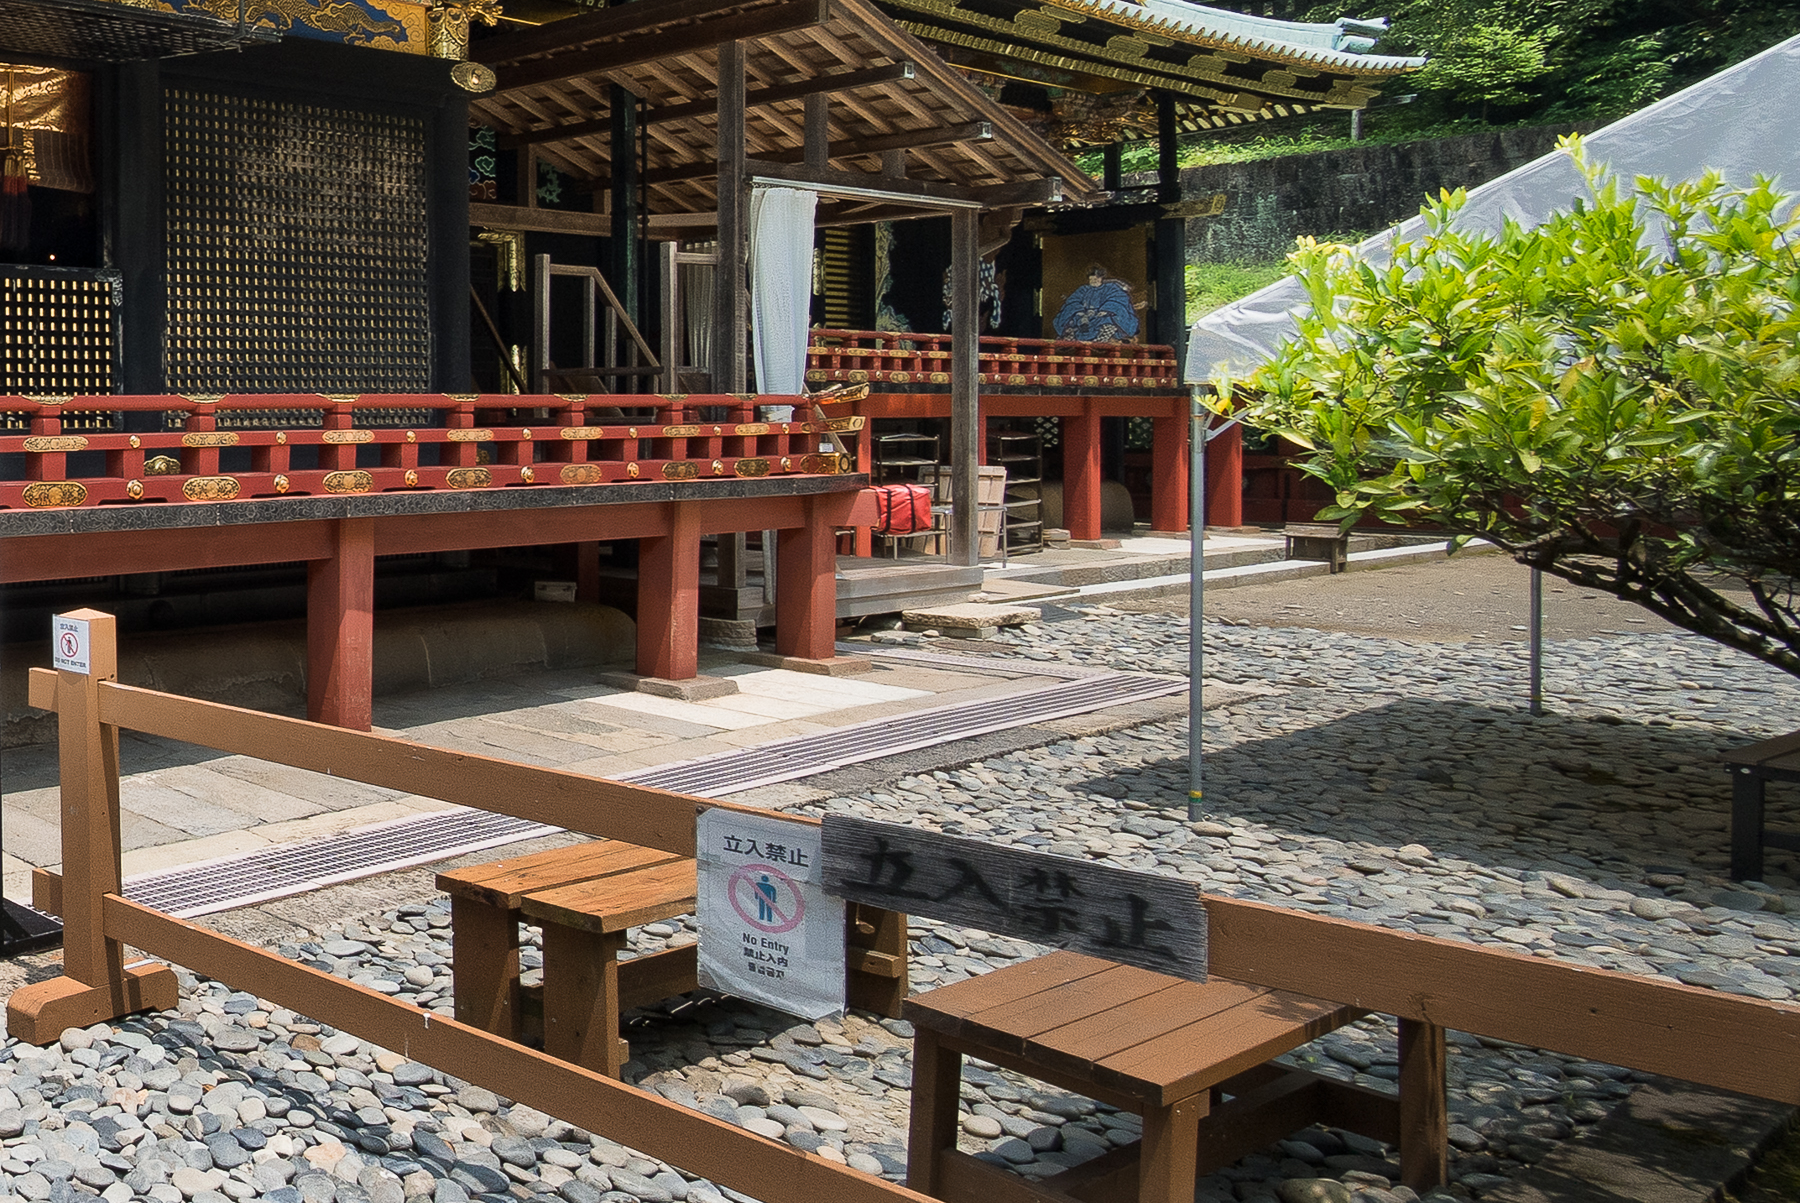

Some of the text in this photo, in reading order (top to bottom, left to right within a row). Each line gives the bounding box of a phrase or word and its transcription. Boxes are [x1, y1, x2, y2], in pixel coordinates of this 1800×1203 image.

[723, 835, 809, 868] 立入禁止
[840, 836, 1179, 963] 立入禁止
[743, 932, 789, 955] No Entry
